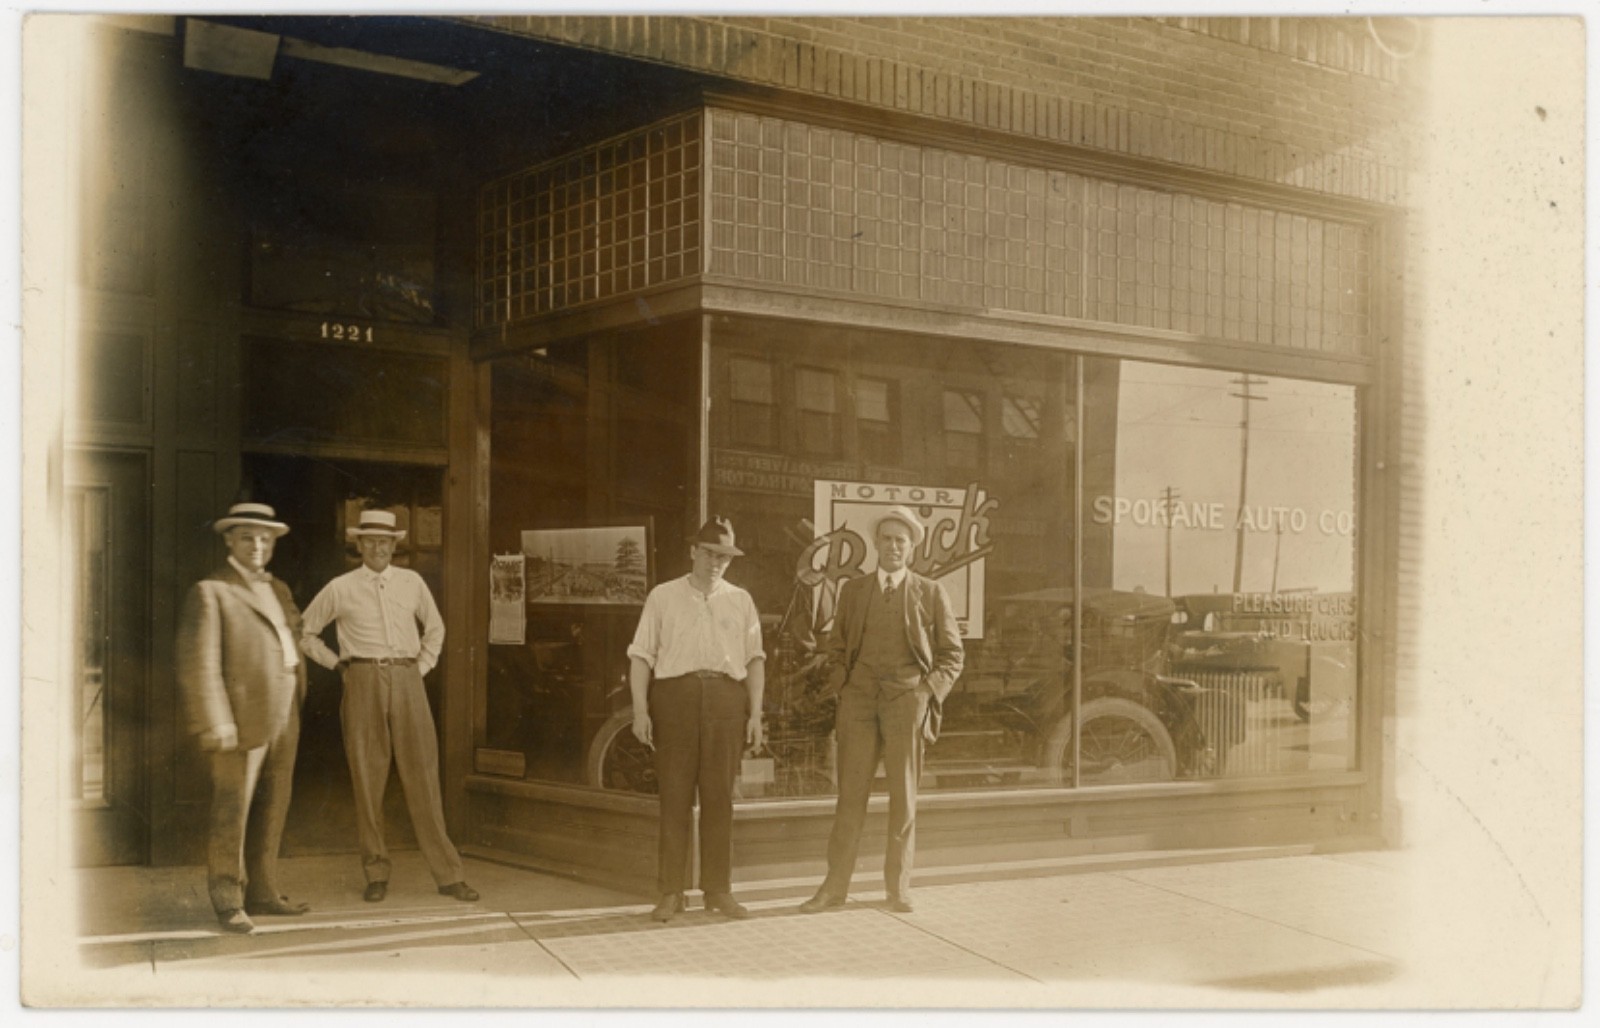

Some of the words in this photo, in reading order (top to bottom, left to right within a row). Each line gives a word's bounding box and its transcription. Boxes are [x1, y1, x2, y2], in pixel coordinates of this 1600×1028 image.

[321, 322, 373, 342] 1221
[831, 484, 953, 503] MOTOR
[1093, 495, 1225, 530] SPOKANE
[1237, 506, 1307, 534] AUTO
[797, 481, 998, 586] Bick
[1232, 593, 1312, 614] PLEASURE
[1318, 595, 1357, 616] CARS
